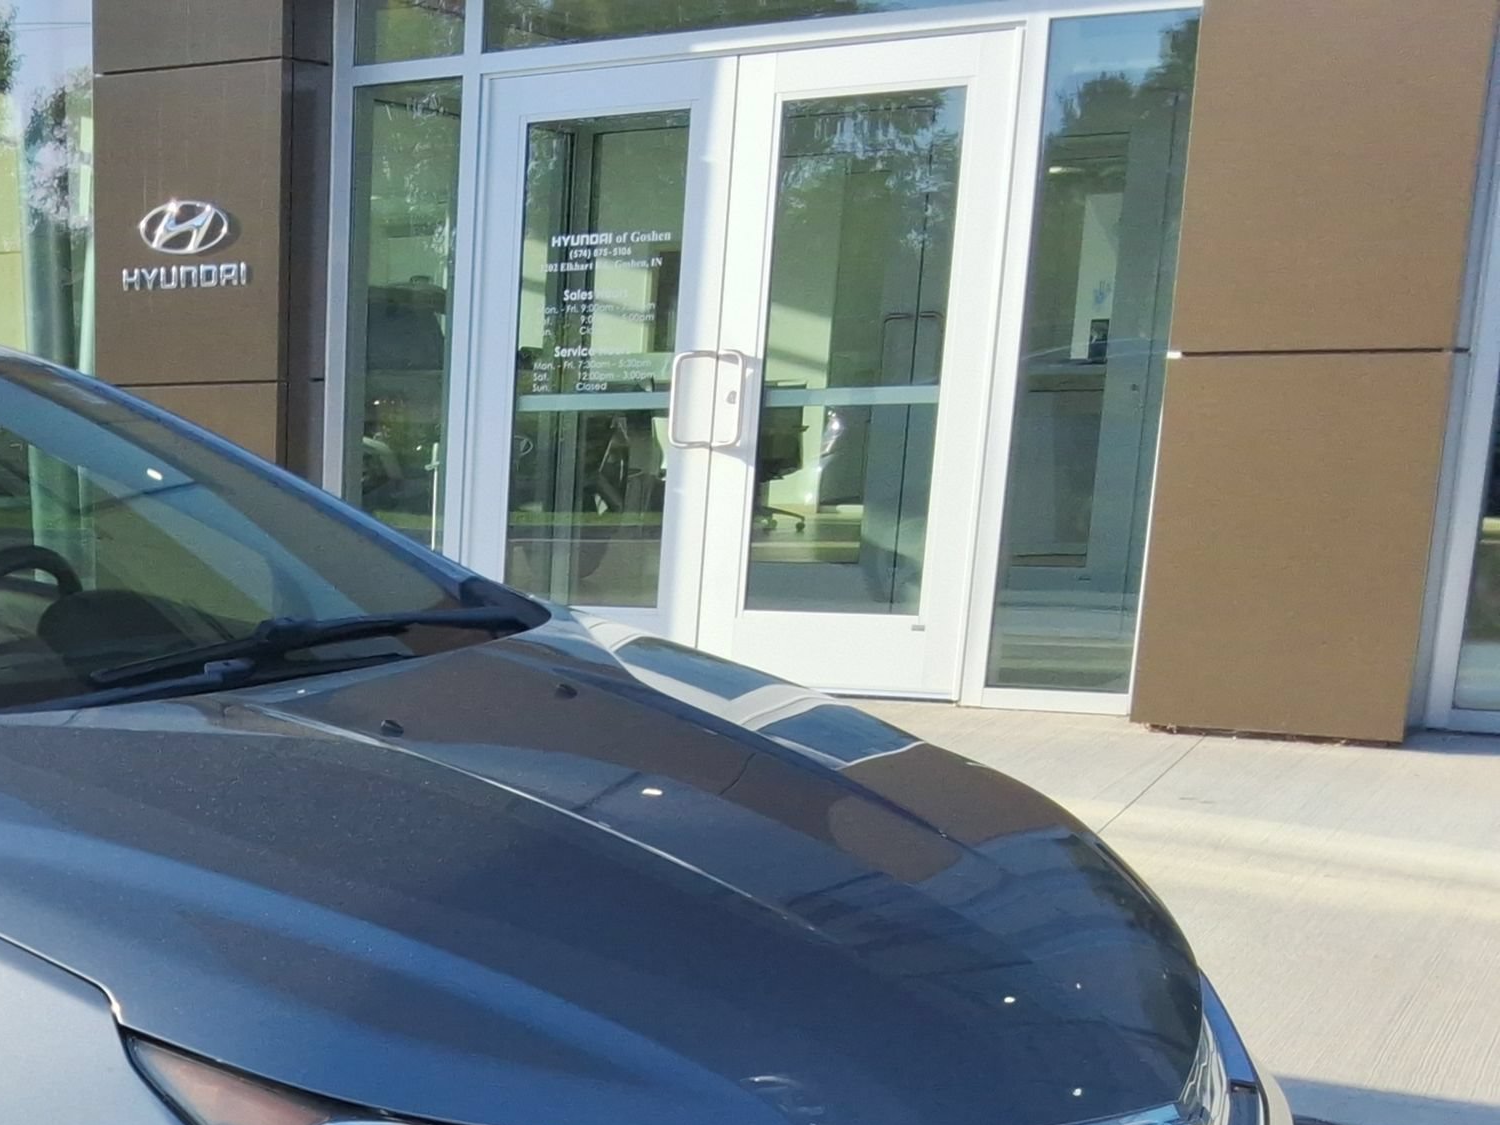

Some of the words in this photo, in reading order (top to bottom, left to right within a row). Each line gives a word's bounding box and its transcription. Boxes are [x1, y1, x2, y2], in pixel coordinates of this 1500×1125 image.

[551, 232, 613, 248] HYUNDAI
[615, 232, 629, 244] of
[630, 229, 671, 243] Goshen
[569, 247, 591, 260] (574)
[560, 260, 594, 273] Elkhart
[651, 256, 663, 268] IN
[122, 262, 247, 291] HYUNDAI
[563, 288, 593, 301] Sales
[554, 345, 595, 358] Service
[532, 382, 550, 393] Sun.
[575, 381, 607, 392] Closed
